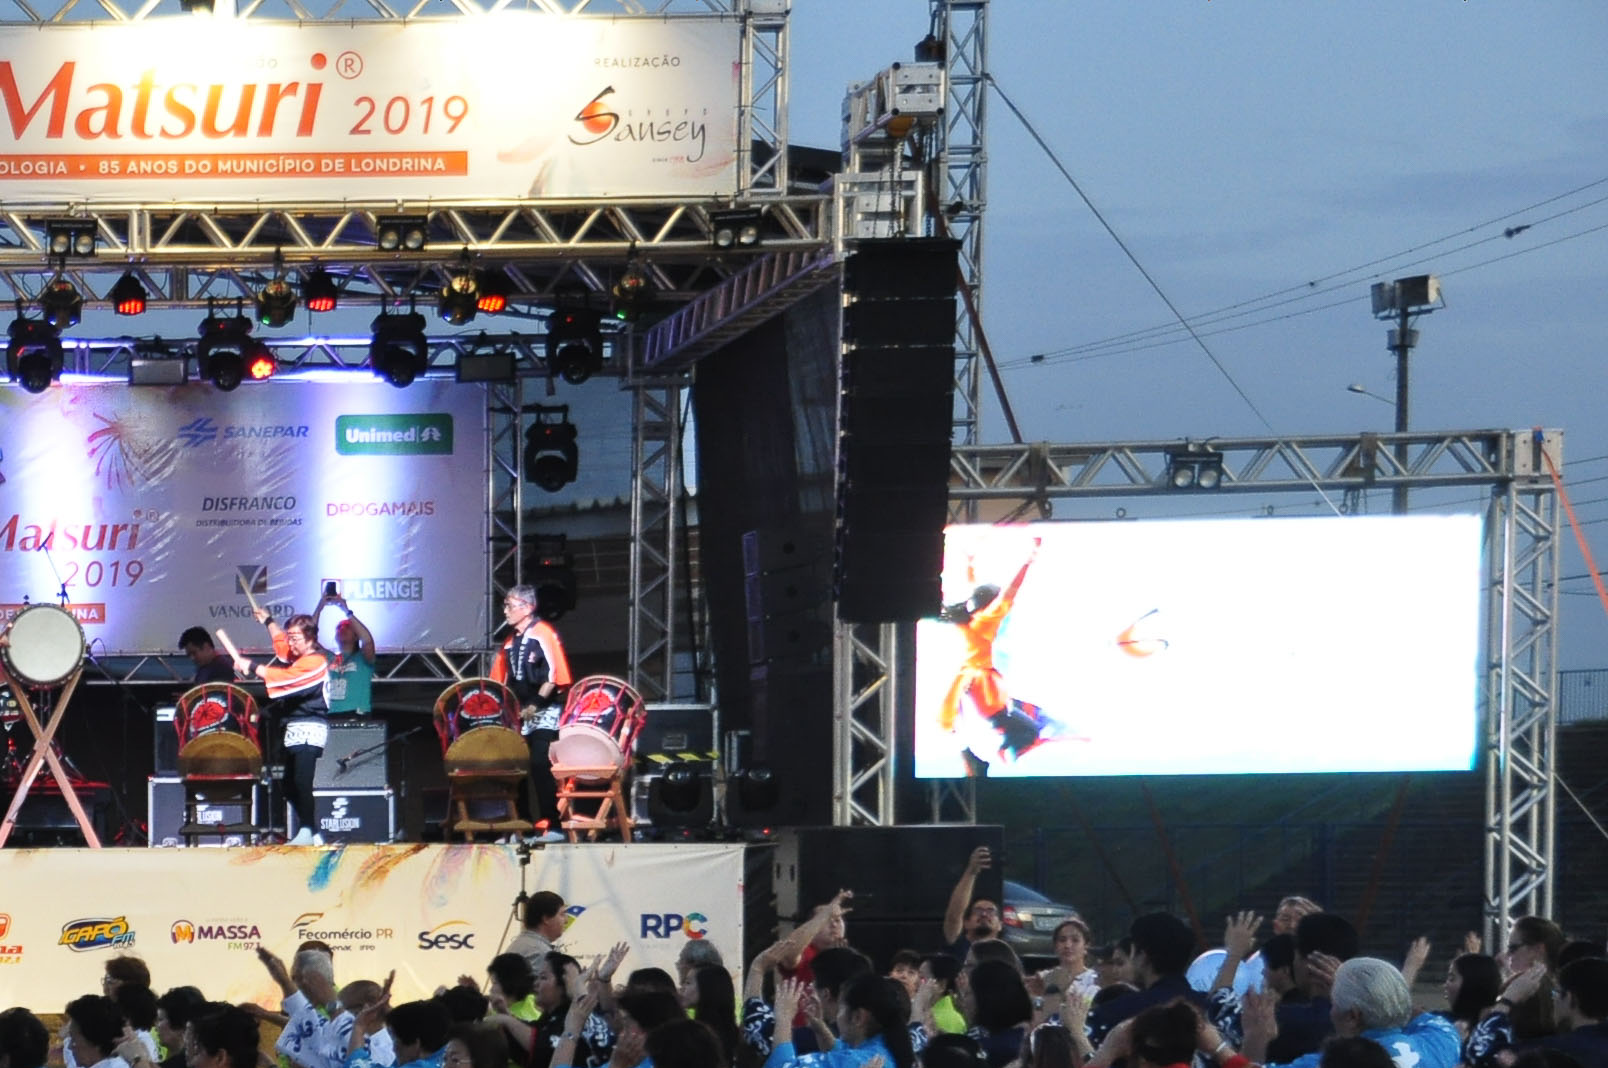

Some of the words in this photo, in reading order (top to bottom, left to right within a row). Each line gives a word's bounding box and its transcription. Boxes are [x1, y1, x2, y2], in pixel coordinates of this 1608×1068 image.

[594, 54, 681, 69] REALIZAÇÃO
[348, 95, 470, 136] 2019
[98, 160, 121, 174] 85
[126, 160, 179, 174] ANOS
[184, 160, 212, 174] DO
[217, 155, 315, 173] MUNICÍPIO
[321, 159, 345, 173] DE
[351, 158, 446, 172] LONDRINA
[223, 425, 310, 439] SANEPAR
[345, 427, 416, 443] Unimed
[201, 496, 297, 512] DISFRANCO
[63, 559, 144, 588] 2019
[197, 925, 262, 940] MASSA
[298, 928, 372, 940] Fecomércio
[376, 928, 393, 939] PR
[640, 912, 709, 940] RPC
[228, 942, 242, 951] FM
[418, 931, 475, 950] Sesc
